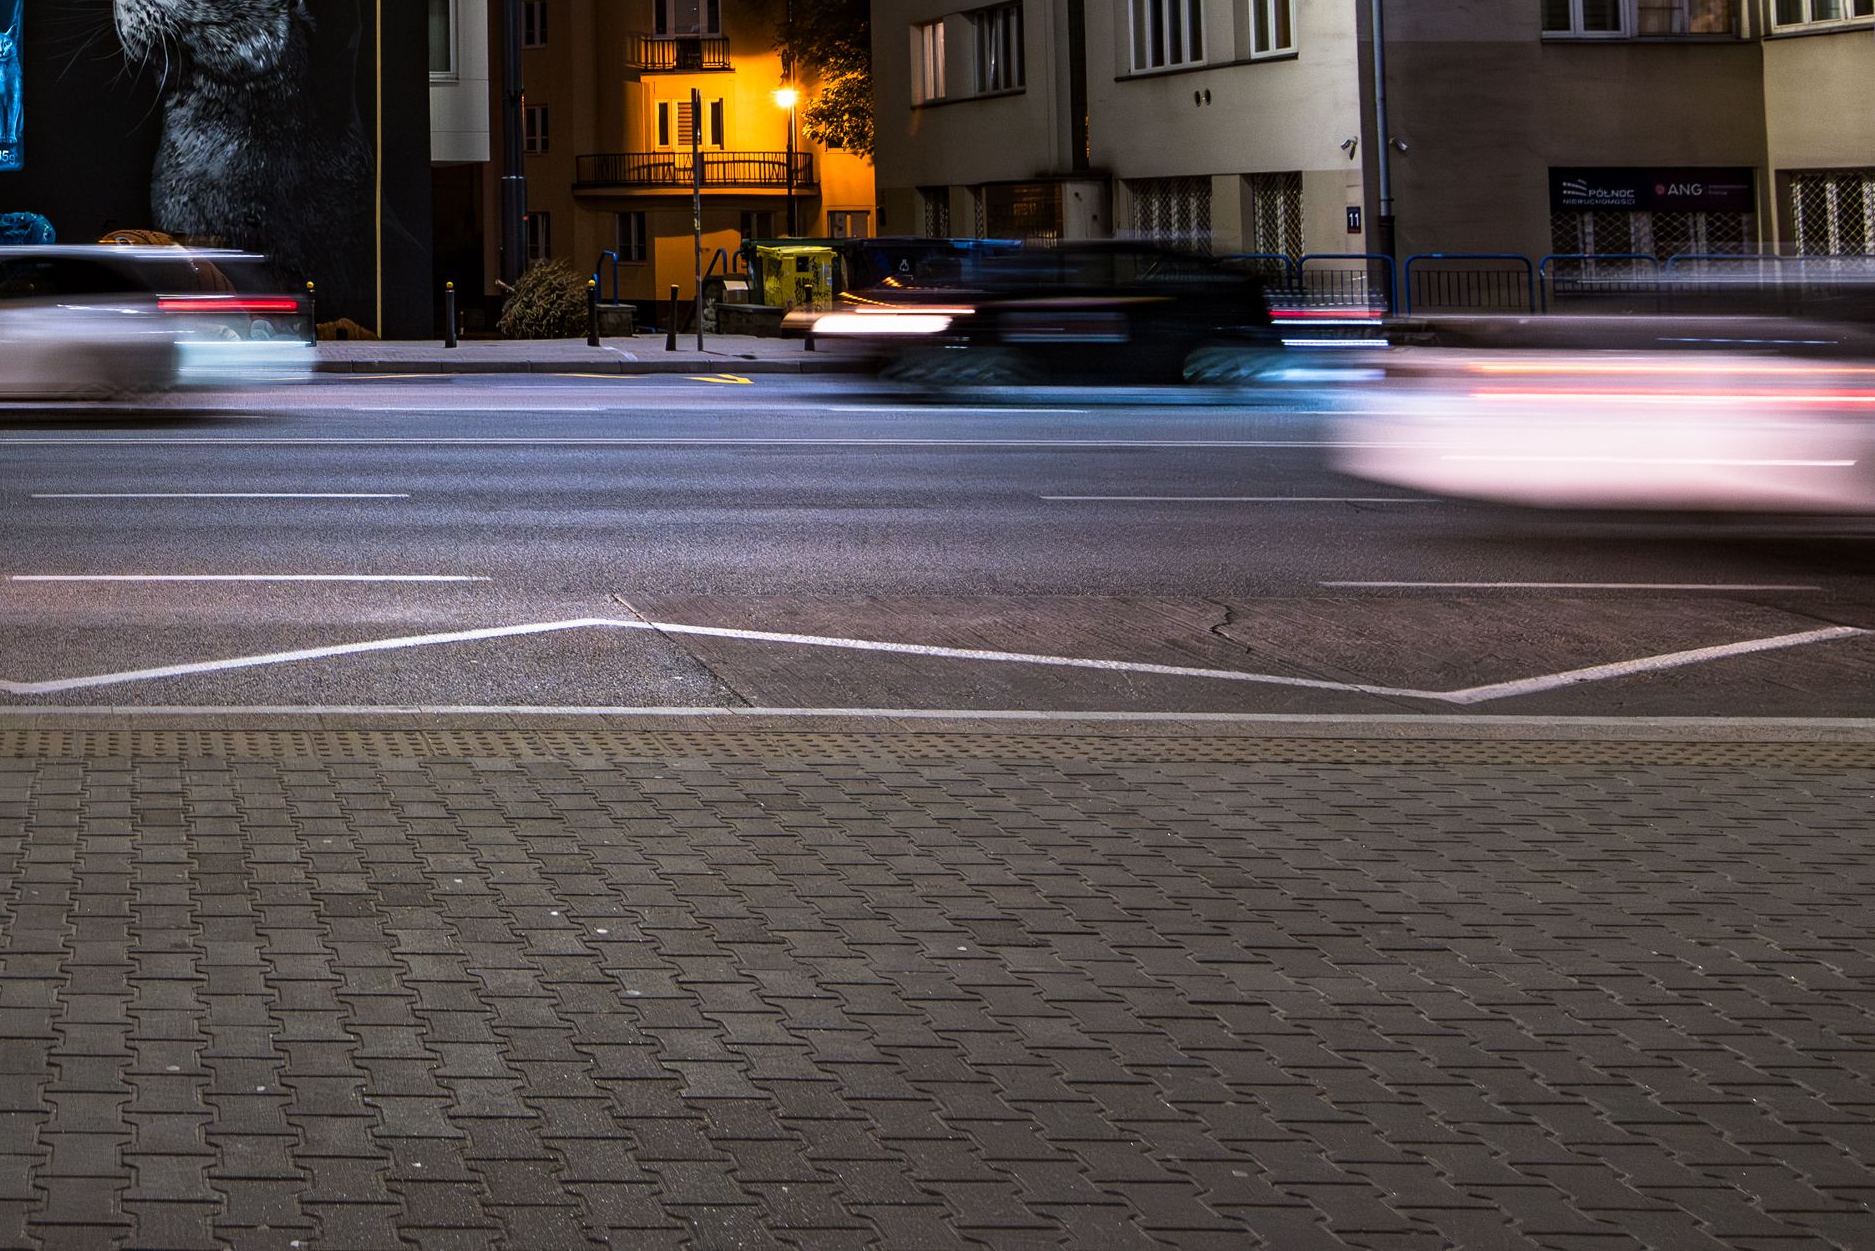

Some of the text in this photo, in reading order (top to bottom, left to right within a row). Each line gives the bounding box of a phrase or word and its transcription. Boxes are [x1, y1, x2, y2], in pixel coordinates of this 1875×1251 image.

[1588, 187, 1635, 198] PÓŁNOC
[1667, 183, 1703, 196] ANG
[1348, 212, 1360, 227] 11
